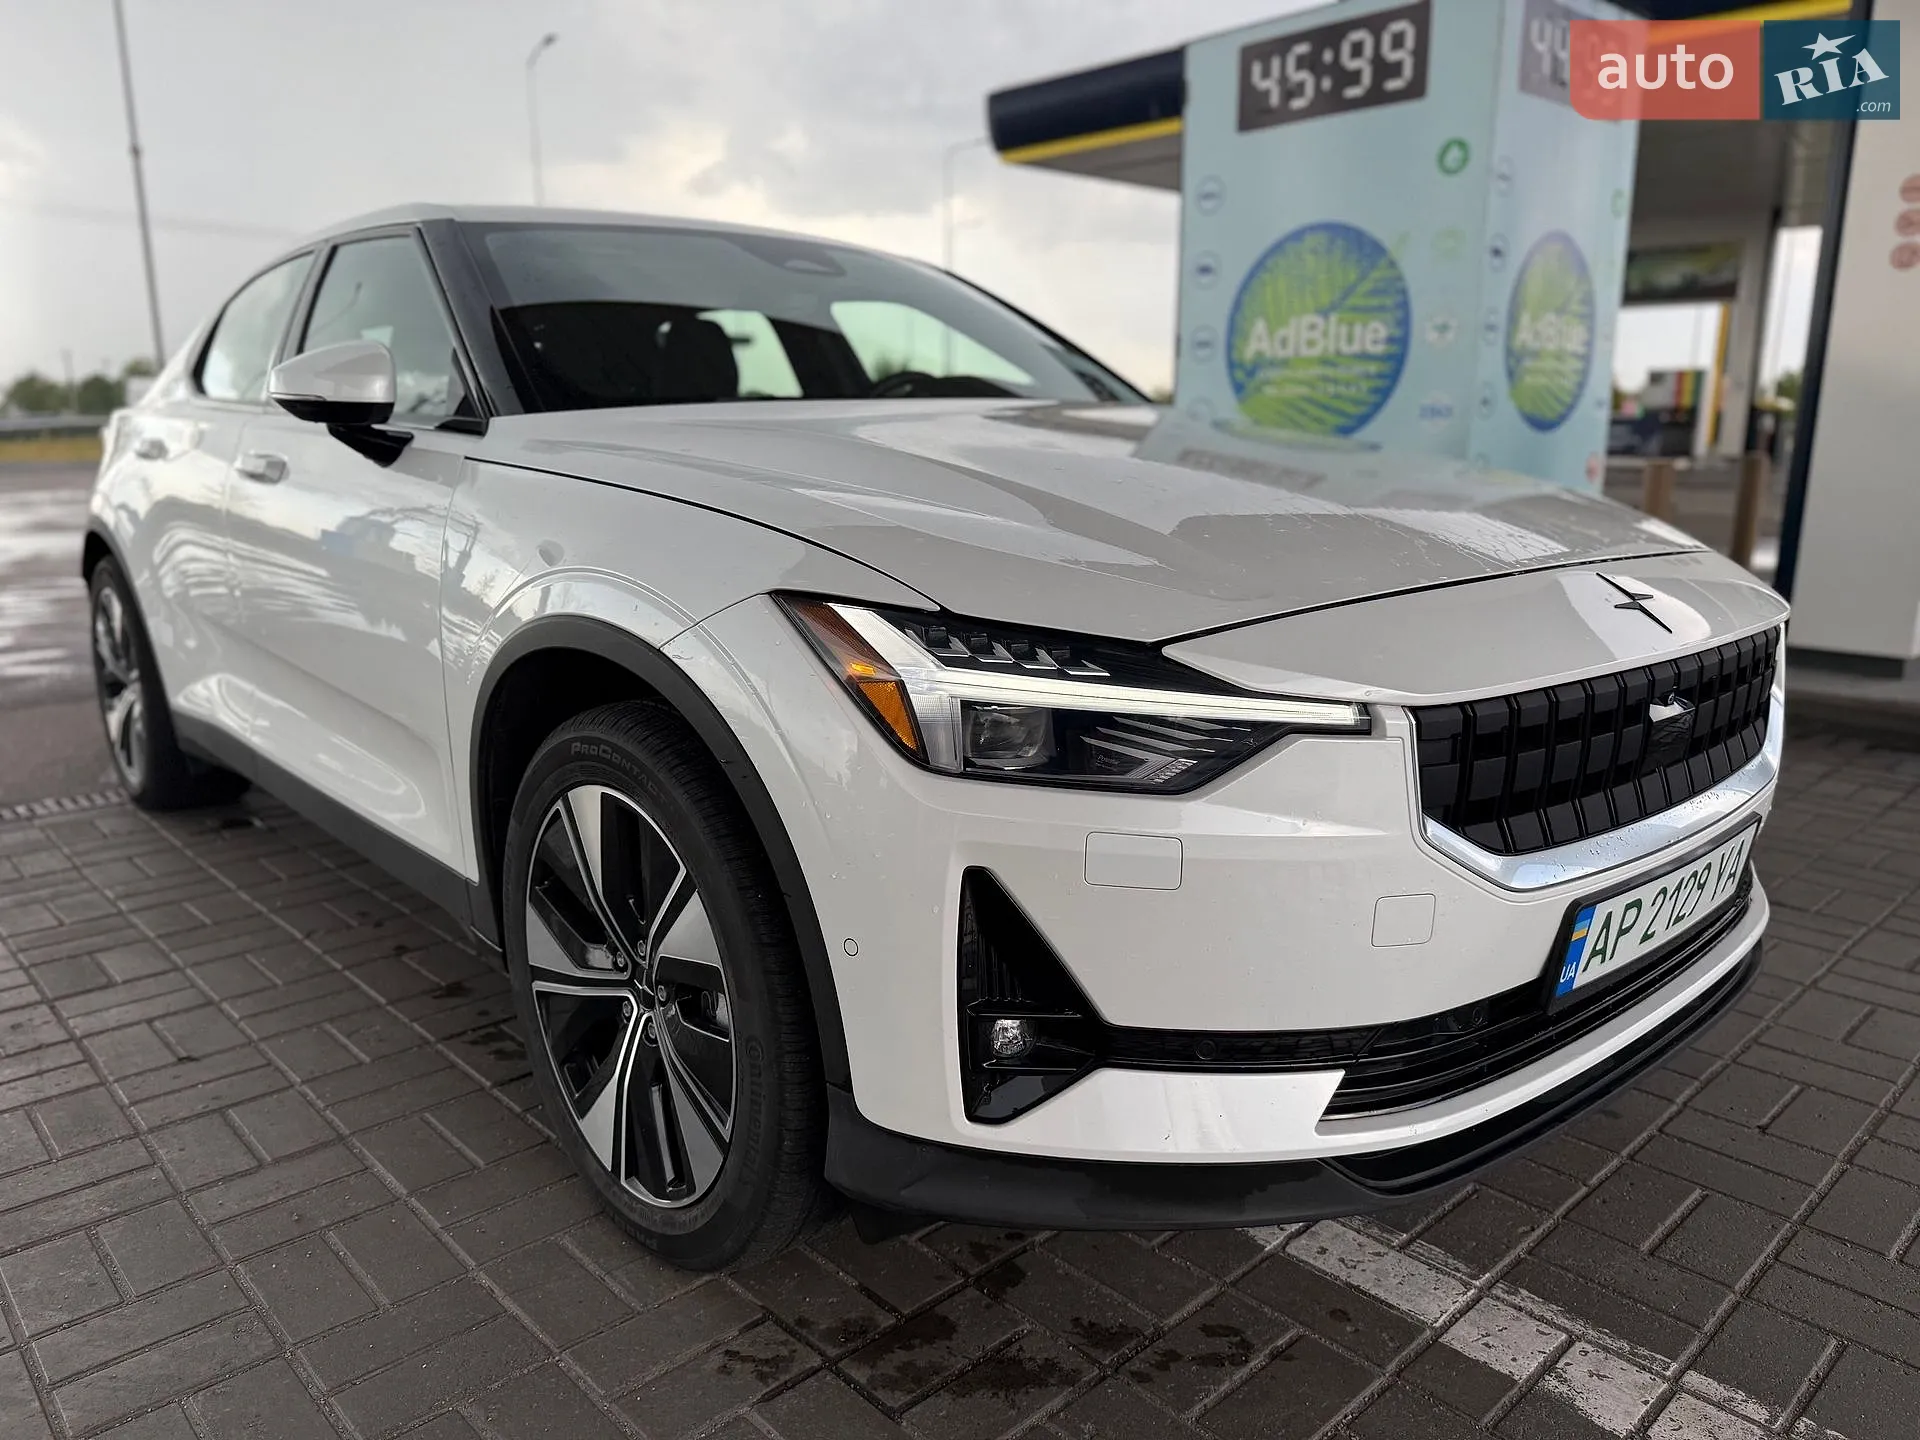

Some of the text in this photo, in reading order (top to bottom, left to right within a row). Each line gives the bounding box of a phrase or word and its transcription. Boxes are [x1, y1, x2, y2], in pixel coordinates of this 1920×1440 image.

[1251, 18, 1416, 111] 45:99
[1244, 313, 1389, 362] AdBlue
[1582, 839, 1745, 973] AP 2129 YA
[1560, 961, 1577, 983] UA
